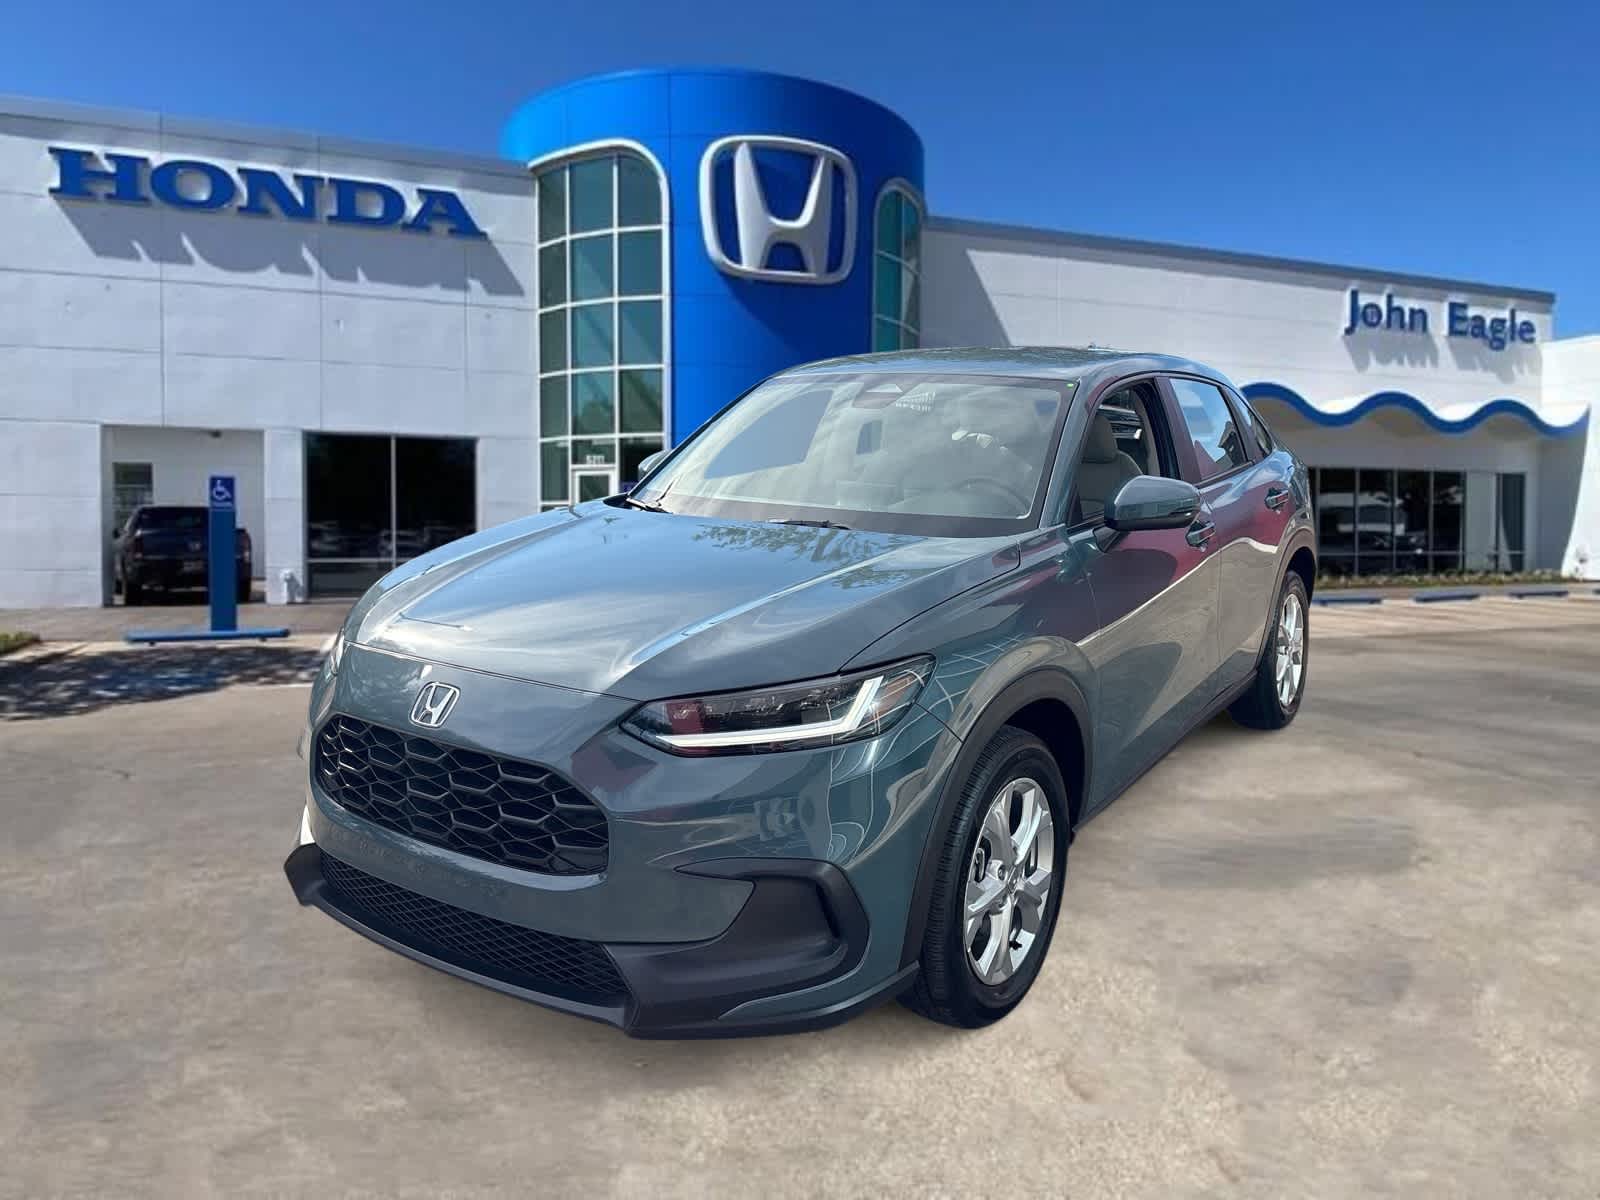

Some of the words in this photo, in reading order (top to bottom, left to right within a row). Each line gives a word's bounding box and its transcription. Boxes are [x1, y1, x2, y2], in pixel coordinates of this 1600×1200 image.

[48, 146, 488, 239] HONDA
[1344, 289, 1427, 336] John
[1449, 301, 1535, 351] Eagle
